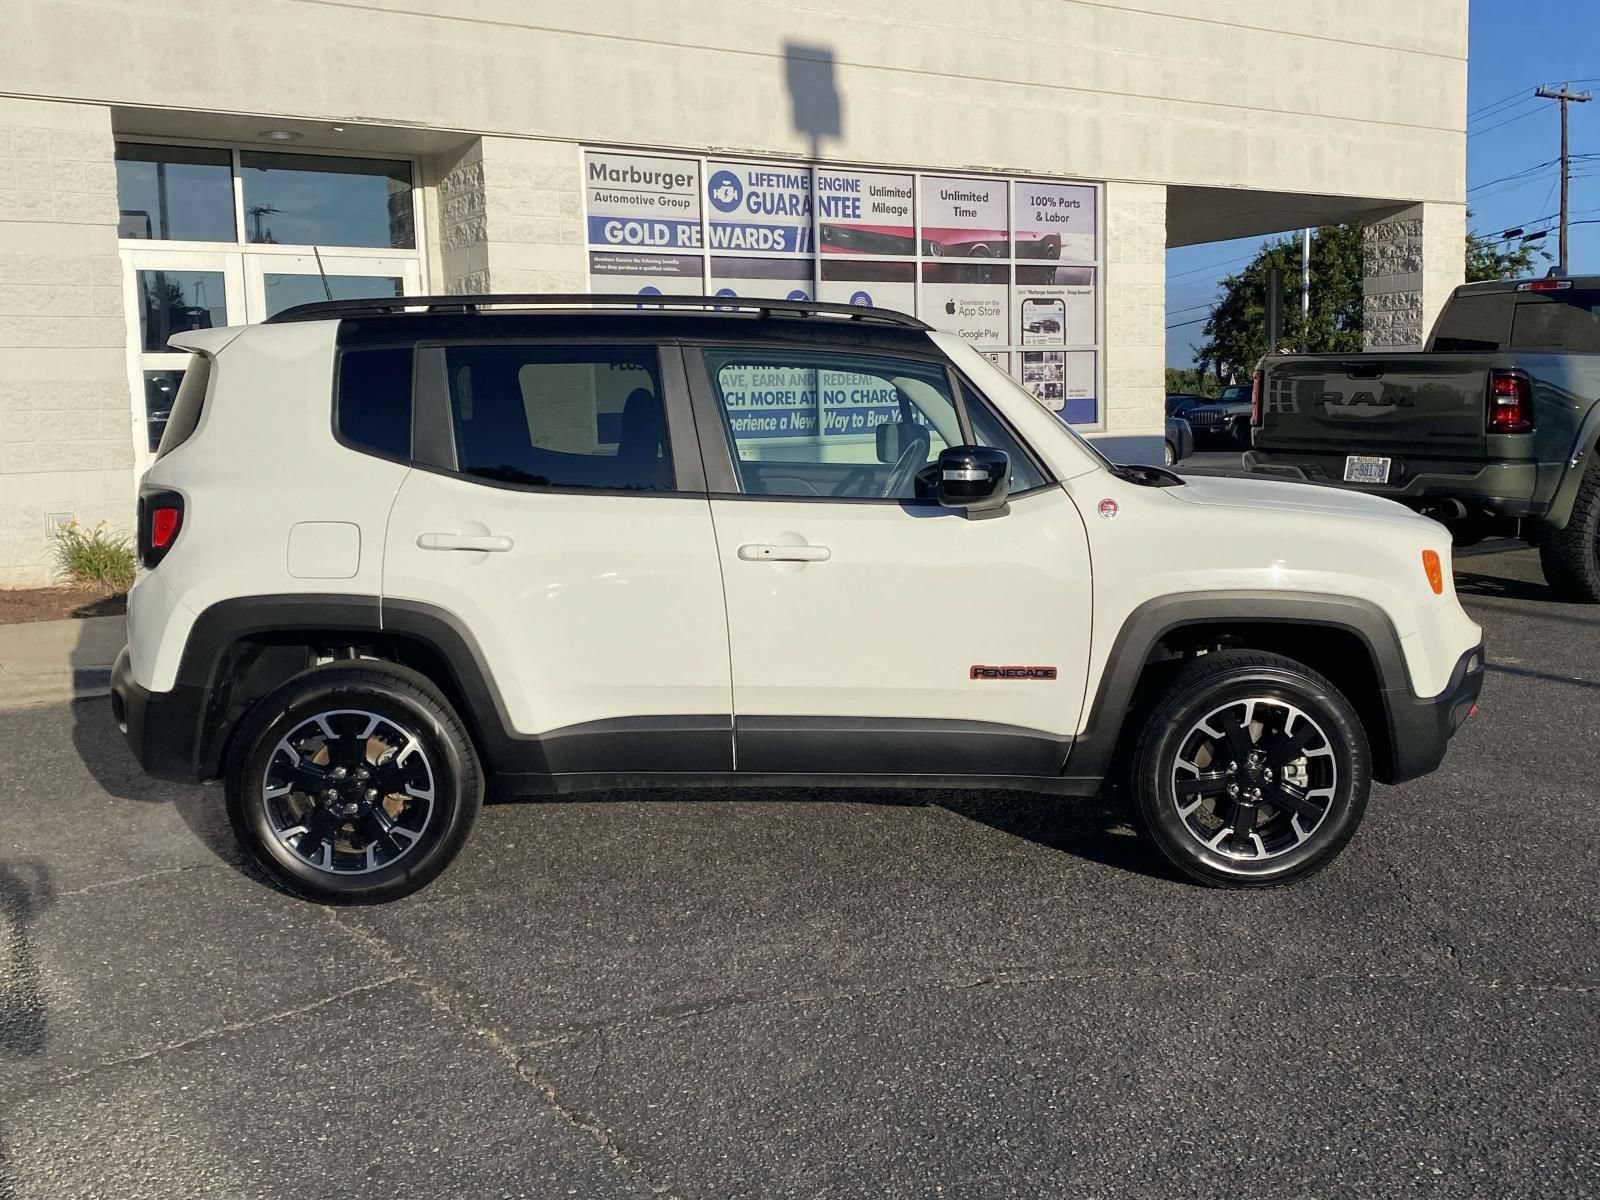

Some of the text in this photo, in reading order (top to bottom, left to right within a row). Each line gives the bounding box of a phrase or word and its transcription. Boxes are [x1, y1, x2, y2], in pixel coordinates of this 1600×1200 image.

[590, 162, 694, 190] Marburger
[748, 172, 861, 193] LIFETIME ENGINE
[869, 185, 912, 199] Unlimited
[940, 190, 989, 203] Unlimited
[594, 191, 691, 210] Automotive Group
[746, 191, 861, 219] GUARANTEE
[1030, 196, 1081, 209] 100% Parts
[872, 202, 908, 216] Mileage
[953, 206, 977, 218] Time
[1035, 211, 1070, 223] & Labor
[604, 220, 786, 250] GOLD REWARDS
[959, 306, 1001, 318] App Store
[958, 328, 1000, 341] Google Play
[721, 373, 873, 389] AVE, EARN AND REDEEM!
[724, 388, 898, 406] CH MORE! AT NO CHARG
[1314, 391, 1416, 408] RAM
[780, 417, 788, 431] a
[790, 412, 816, 430] New
[824, 410, 849, 433] Way
[852, 412, 864, 428] to
[970, 664, 1057, 680] RENEGADE
